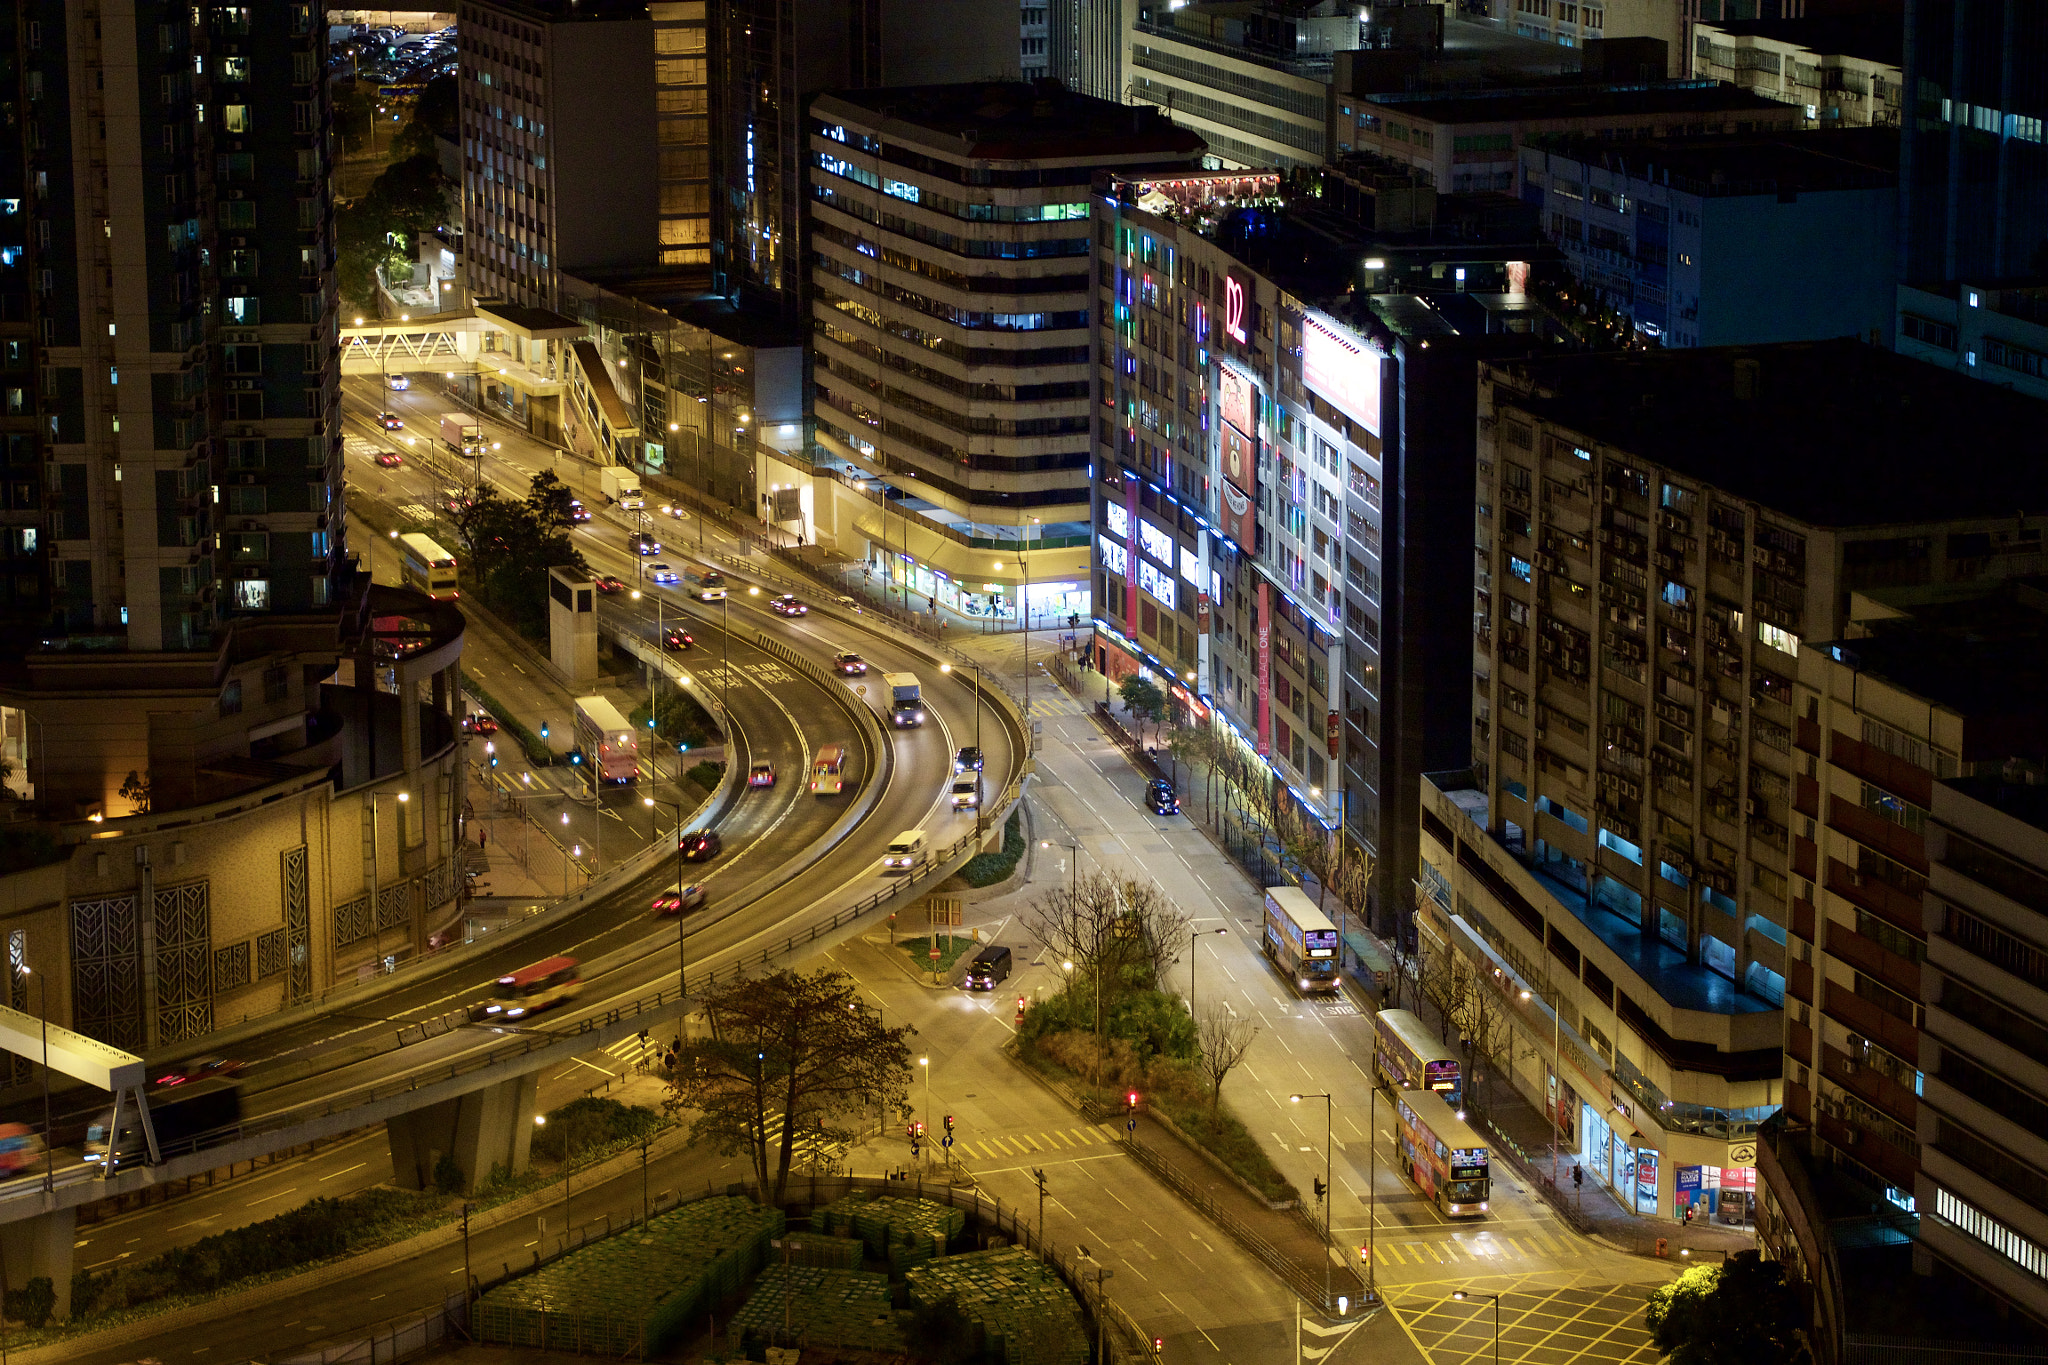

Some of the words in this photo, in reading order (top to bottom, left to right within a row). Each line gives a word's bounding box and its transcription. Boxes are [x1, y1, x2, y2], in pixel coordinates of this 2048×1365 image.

[1226, 275, 1247, 345] D2
[1127, 520, 1135, 541] ONE
[1259, 627, 1268, 648] ONE
[697, 668, 733, 679] SLOW
[744, 662, 780, 674] SLOW
[1259, 652, 1268, 685] PLACE
[1259, 686, 1268, 700] D2
[1325, 1005, 1357, 1015] BUS
